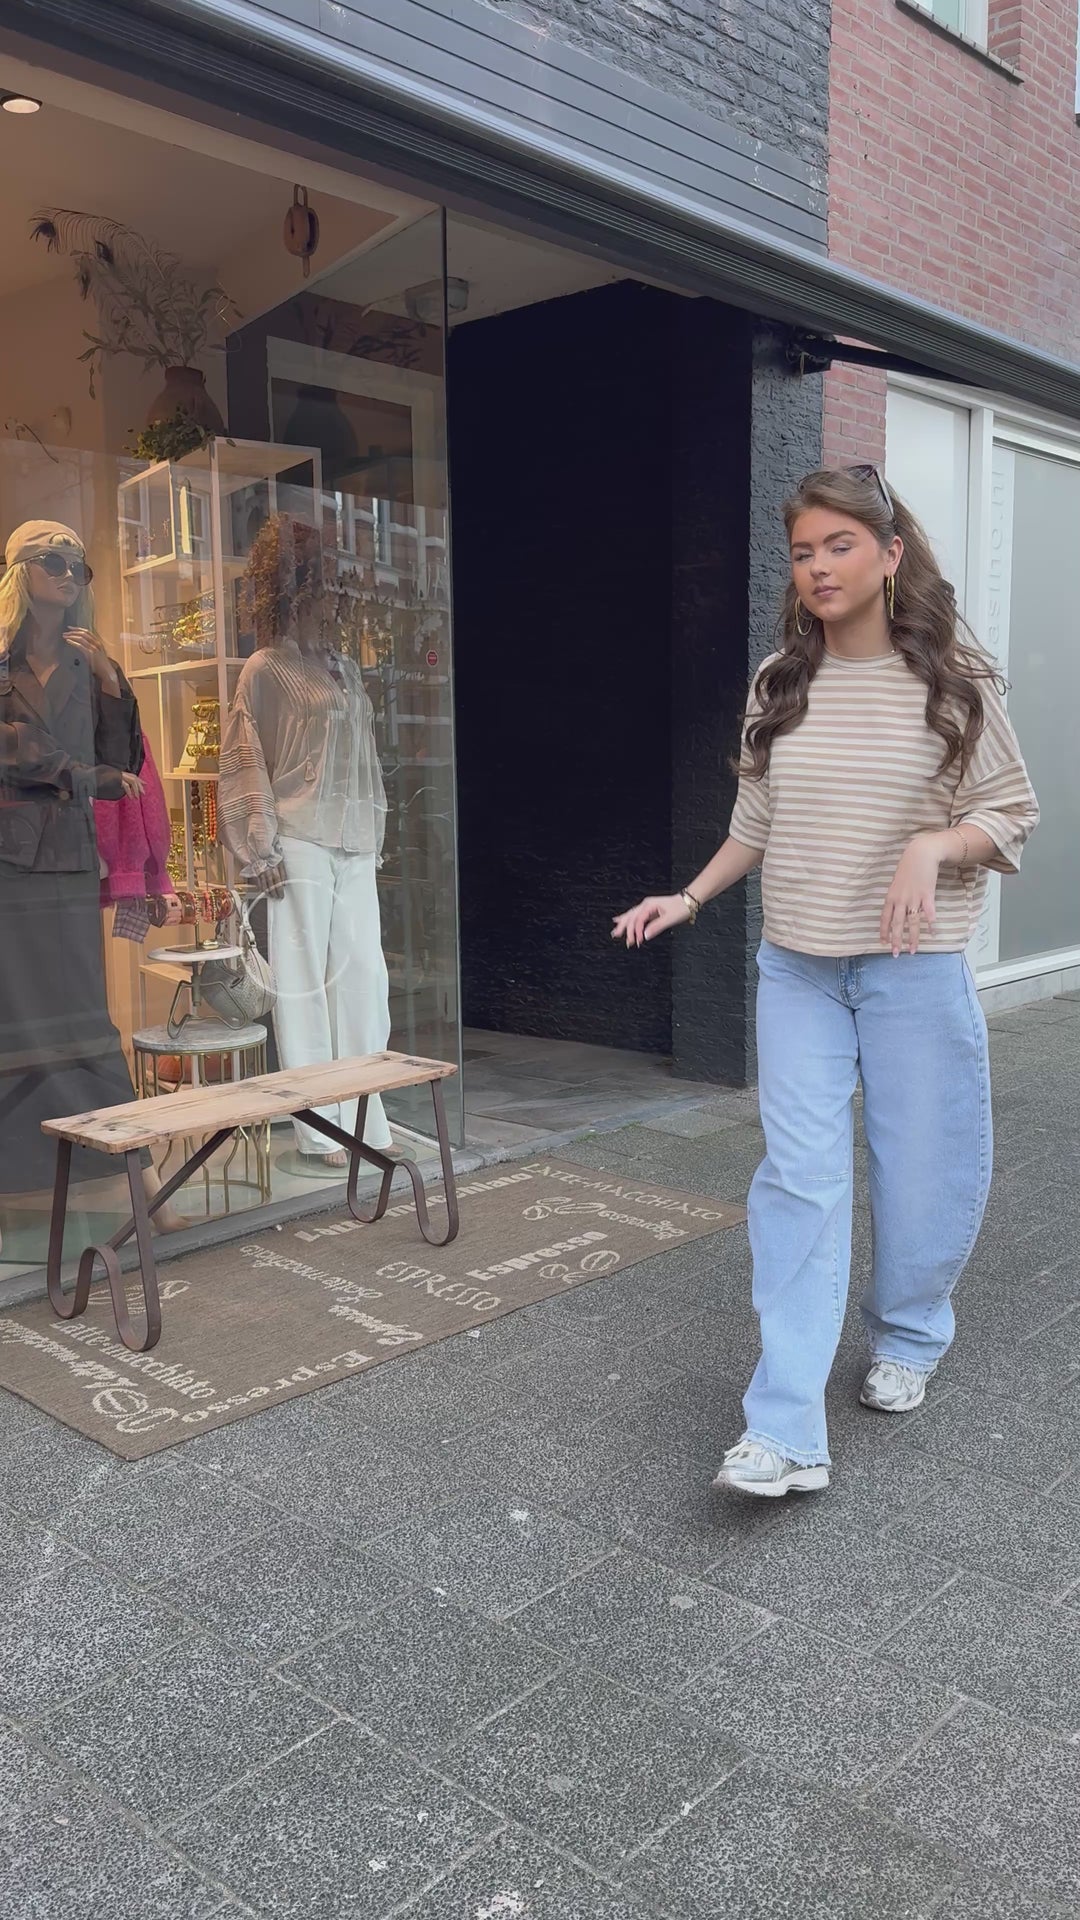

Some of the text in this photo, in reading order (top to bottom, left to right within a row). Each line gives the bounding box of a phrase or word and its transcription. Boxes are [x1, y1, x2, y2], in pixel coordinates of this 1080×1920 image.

[466, 1230, 608, 1281] Espresso
[376, 1261, 501, 1311] ESPRESSO
[181, 1350, 374, 1423] Espresso
